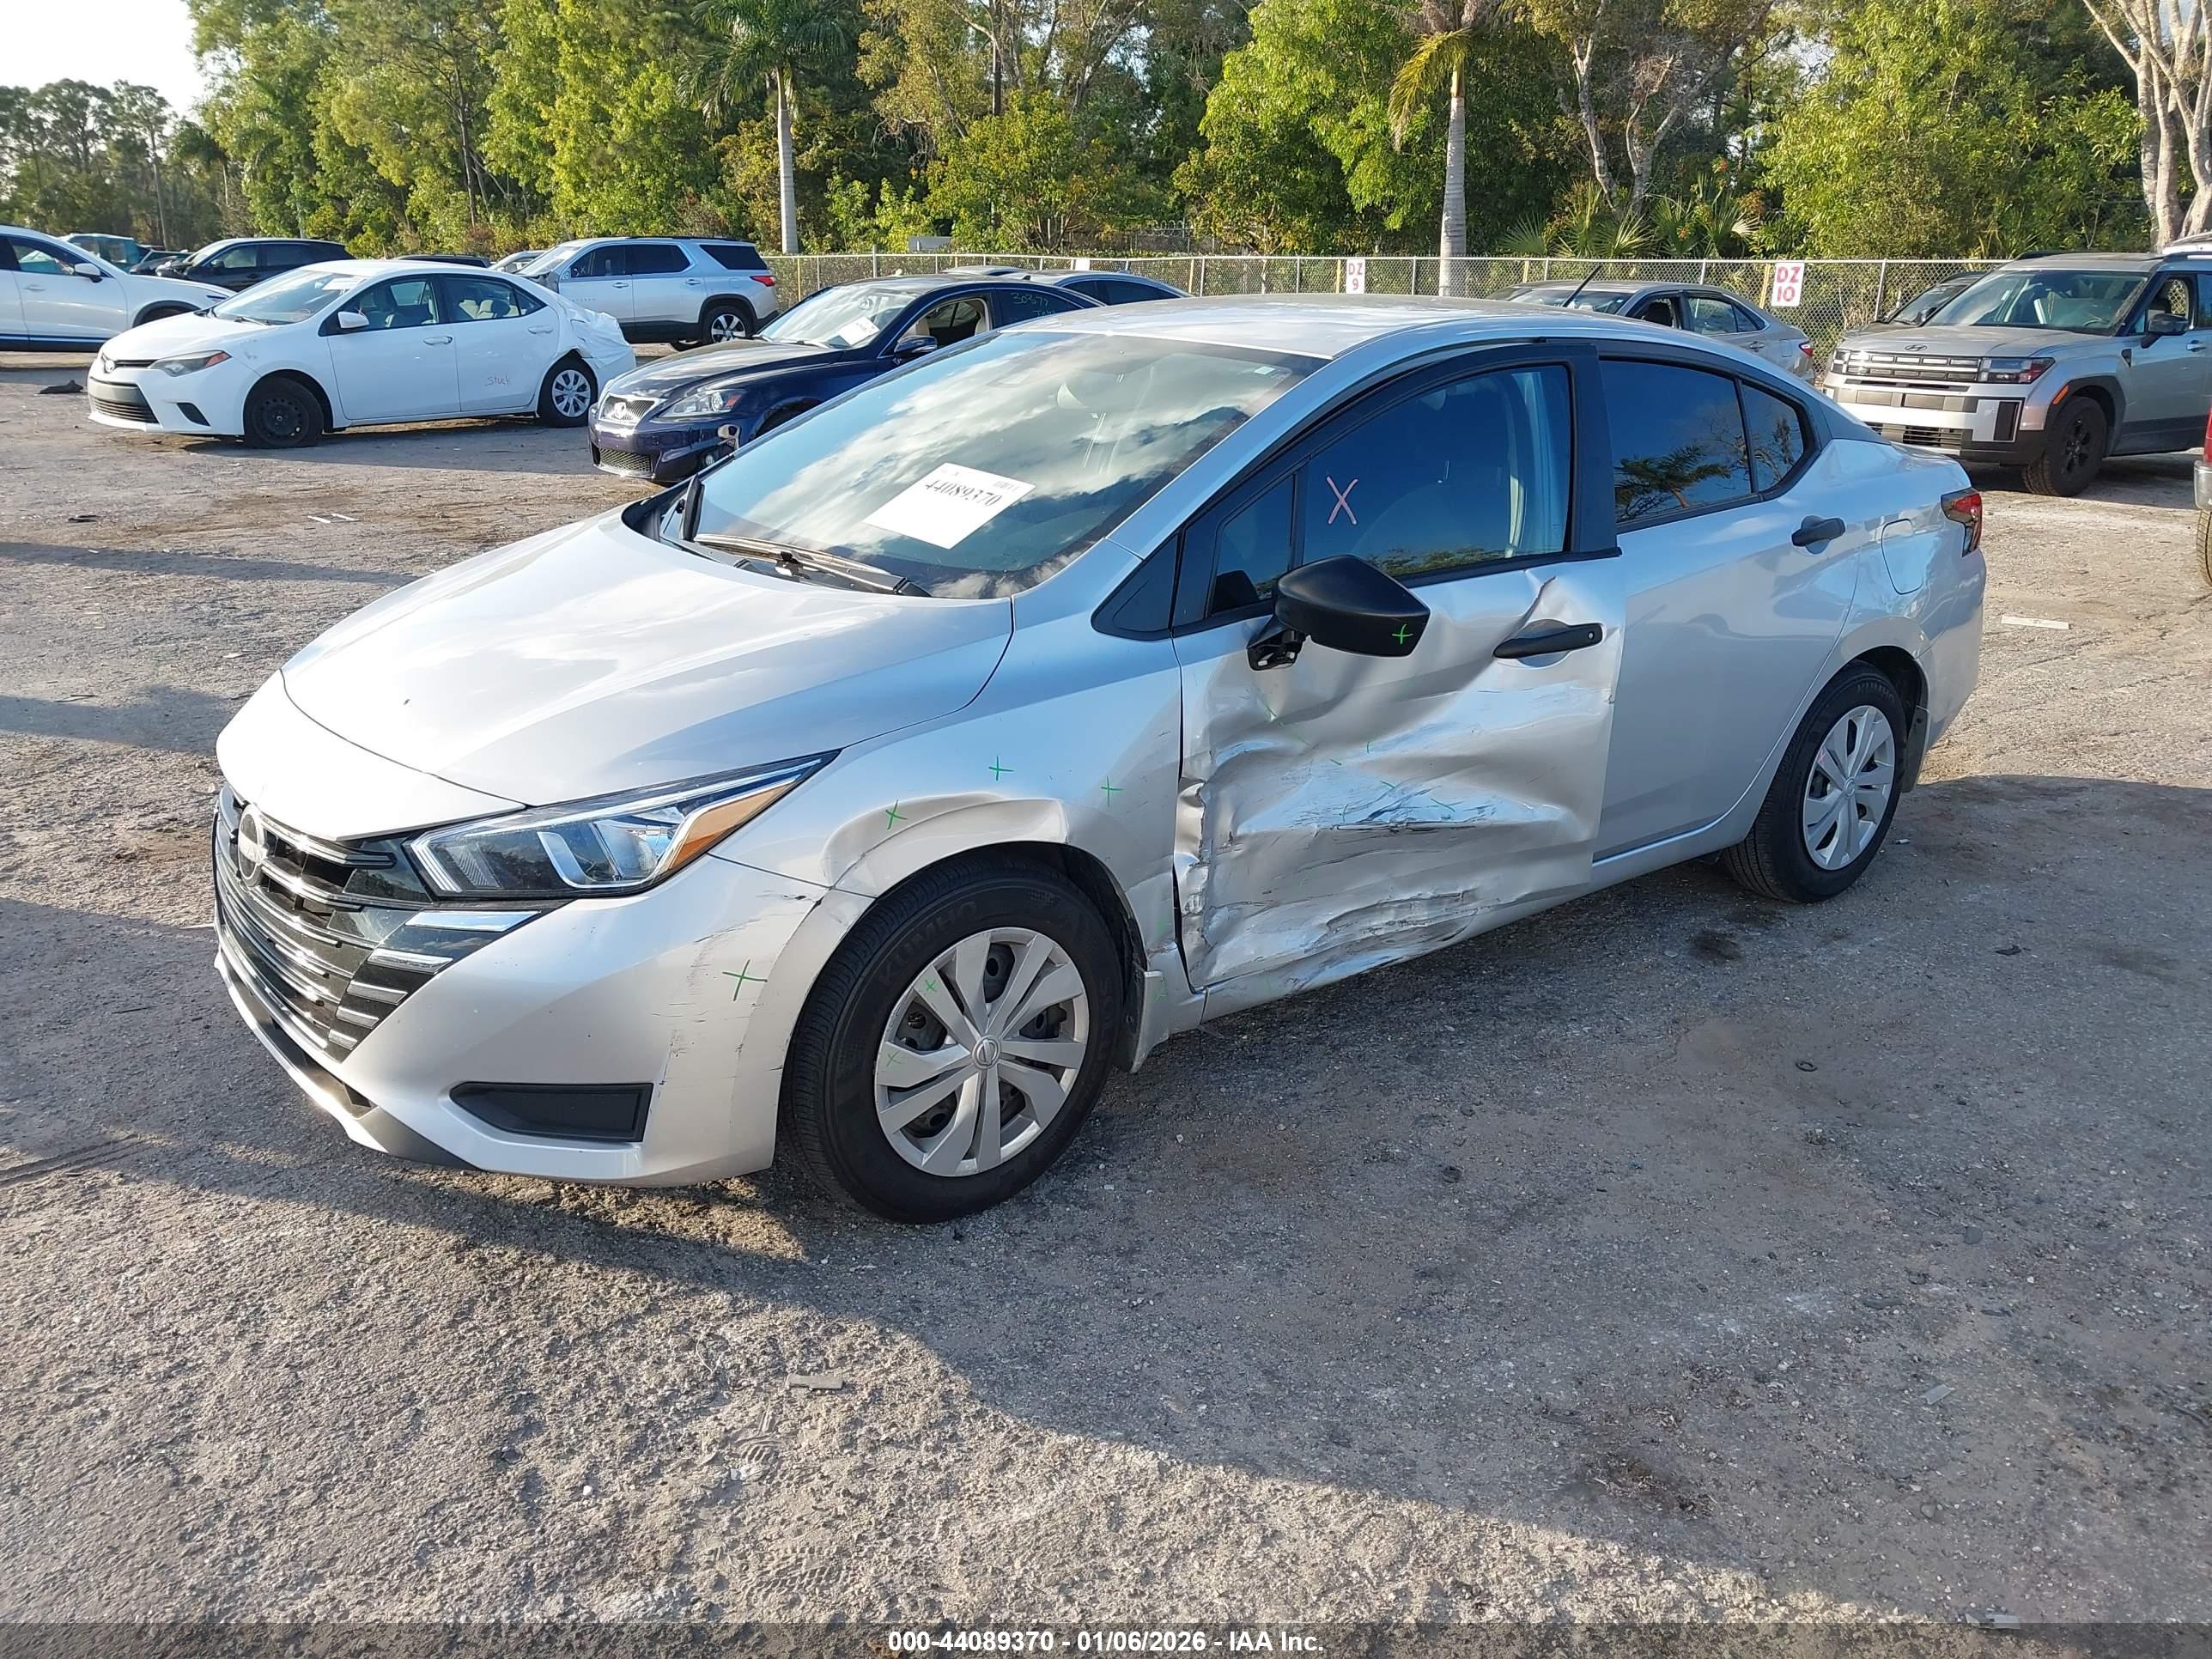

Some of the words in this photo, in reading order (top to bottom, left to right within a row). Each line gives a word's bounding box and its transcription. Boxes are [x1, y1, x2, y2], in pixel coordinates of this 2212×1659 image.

[1348, 263, 1364, 276] DZ
[1777, 266, 1802, 283] DZ
[1352, 278, 1359, 290] 9
[925, 479, 1003, 507] 44089370
[878, 901, 977, 981] KUMHO
